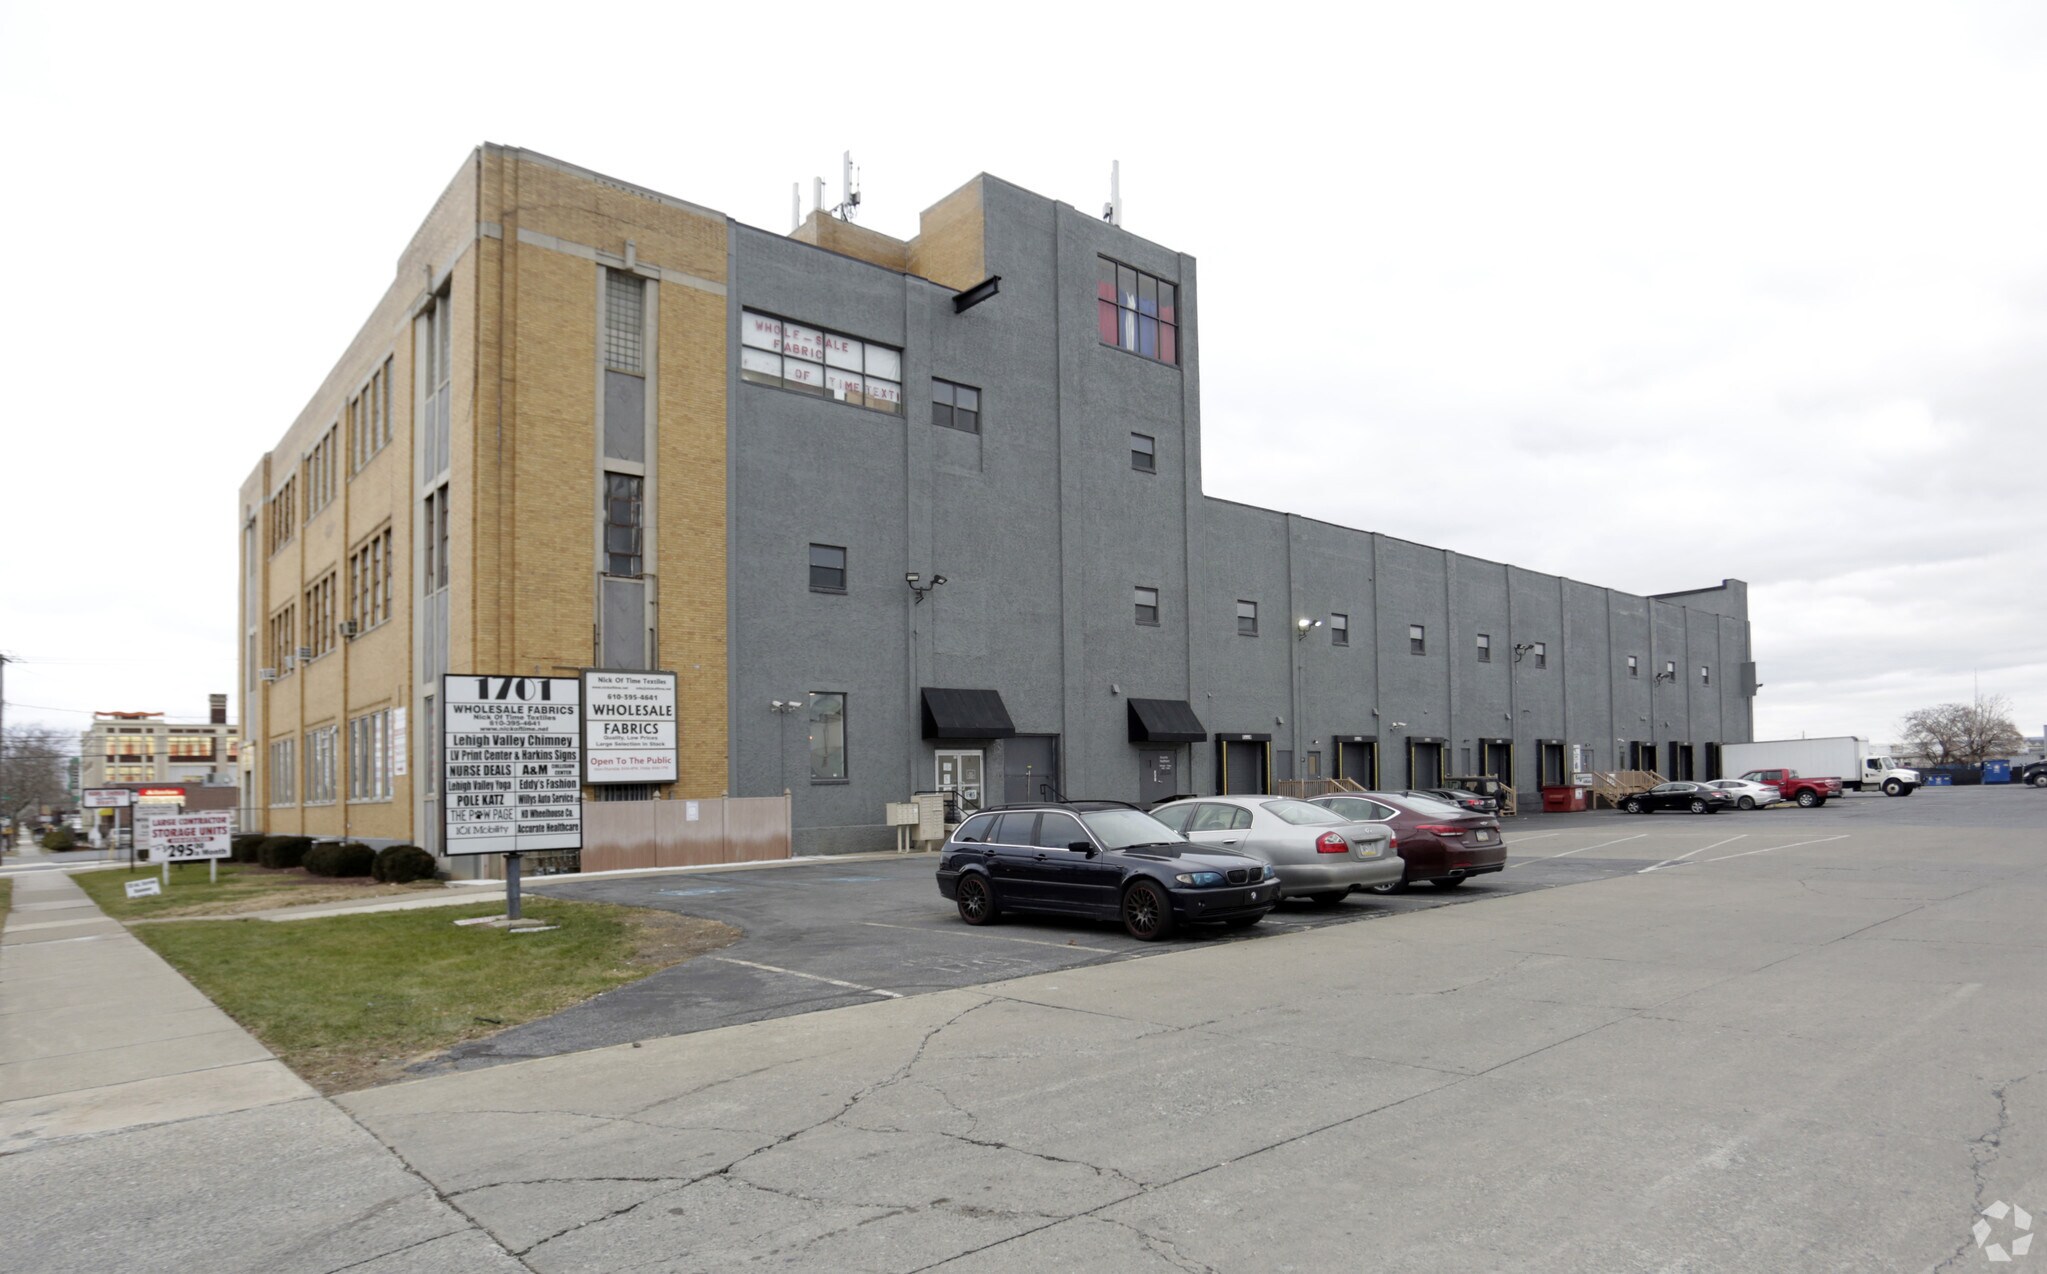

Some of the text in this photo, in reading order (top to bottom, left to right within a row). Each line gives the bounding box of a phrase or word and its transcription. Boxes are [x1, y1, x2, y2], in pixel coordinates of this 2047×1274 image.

[773, 340, 823, 360] FABRIC
[795, 369, 811, 380] OF
[830, 377, 860, 392] TIME
[475, 677, 551, 701] 1701
[454, 705, 574, 715] WHOLESALE FABRICS
[592, 704, 672, 716] WHOLESALE
[604, 723, 659, 734] FABRICS
[454, 735, 572, 747] Lehigh Valley Chimney
[450, 750, 576, 762] LV Print Center & Harkins Signs
[590, 758, 614, 766] Open
[616, 757, 627, 765] To
[450, 765, 512, 776] NURSE DEALS
[522, 765, 548, 775] A&M
[448, 781, 512, 792] Lehigh Valley Yoga
[520, 779, 576, 790] Eddy's Fashion
[458, 795, 504, 806] POLE KATZ
[538, 794, 551, 804] Auto
[552, 794, 574, 803] Service
[450, 810, 466, 821] THE
[493, 809, 513, 820] PAGE
[530, 809, 564, 818] Wheelhouse
[179, 817, 226, 825] CONTRACTOR
[152, 826, 227, 838] STORAGE UNITS
[473, 825, 509, 834] Mobility
[518, 824, 578, 833] Accurate Healthcare
